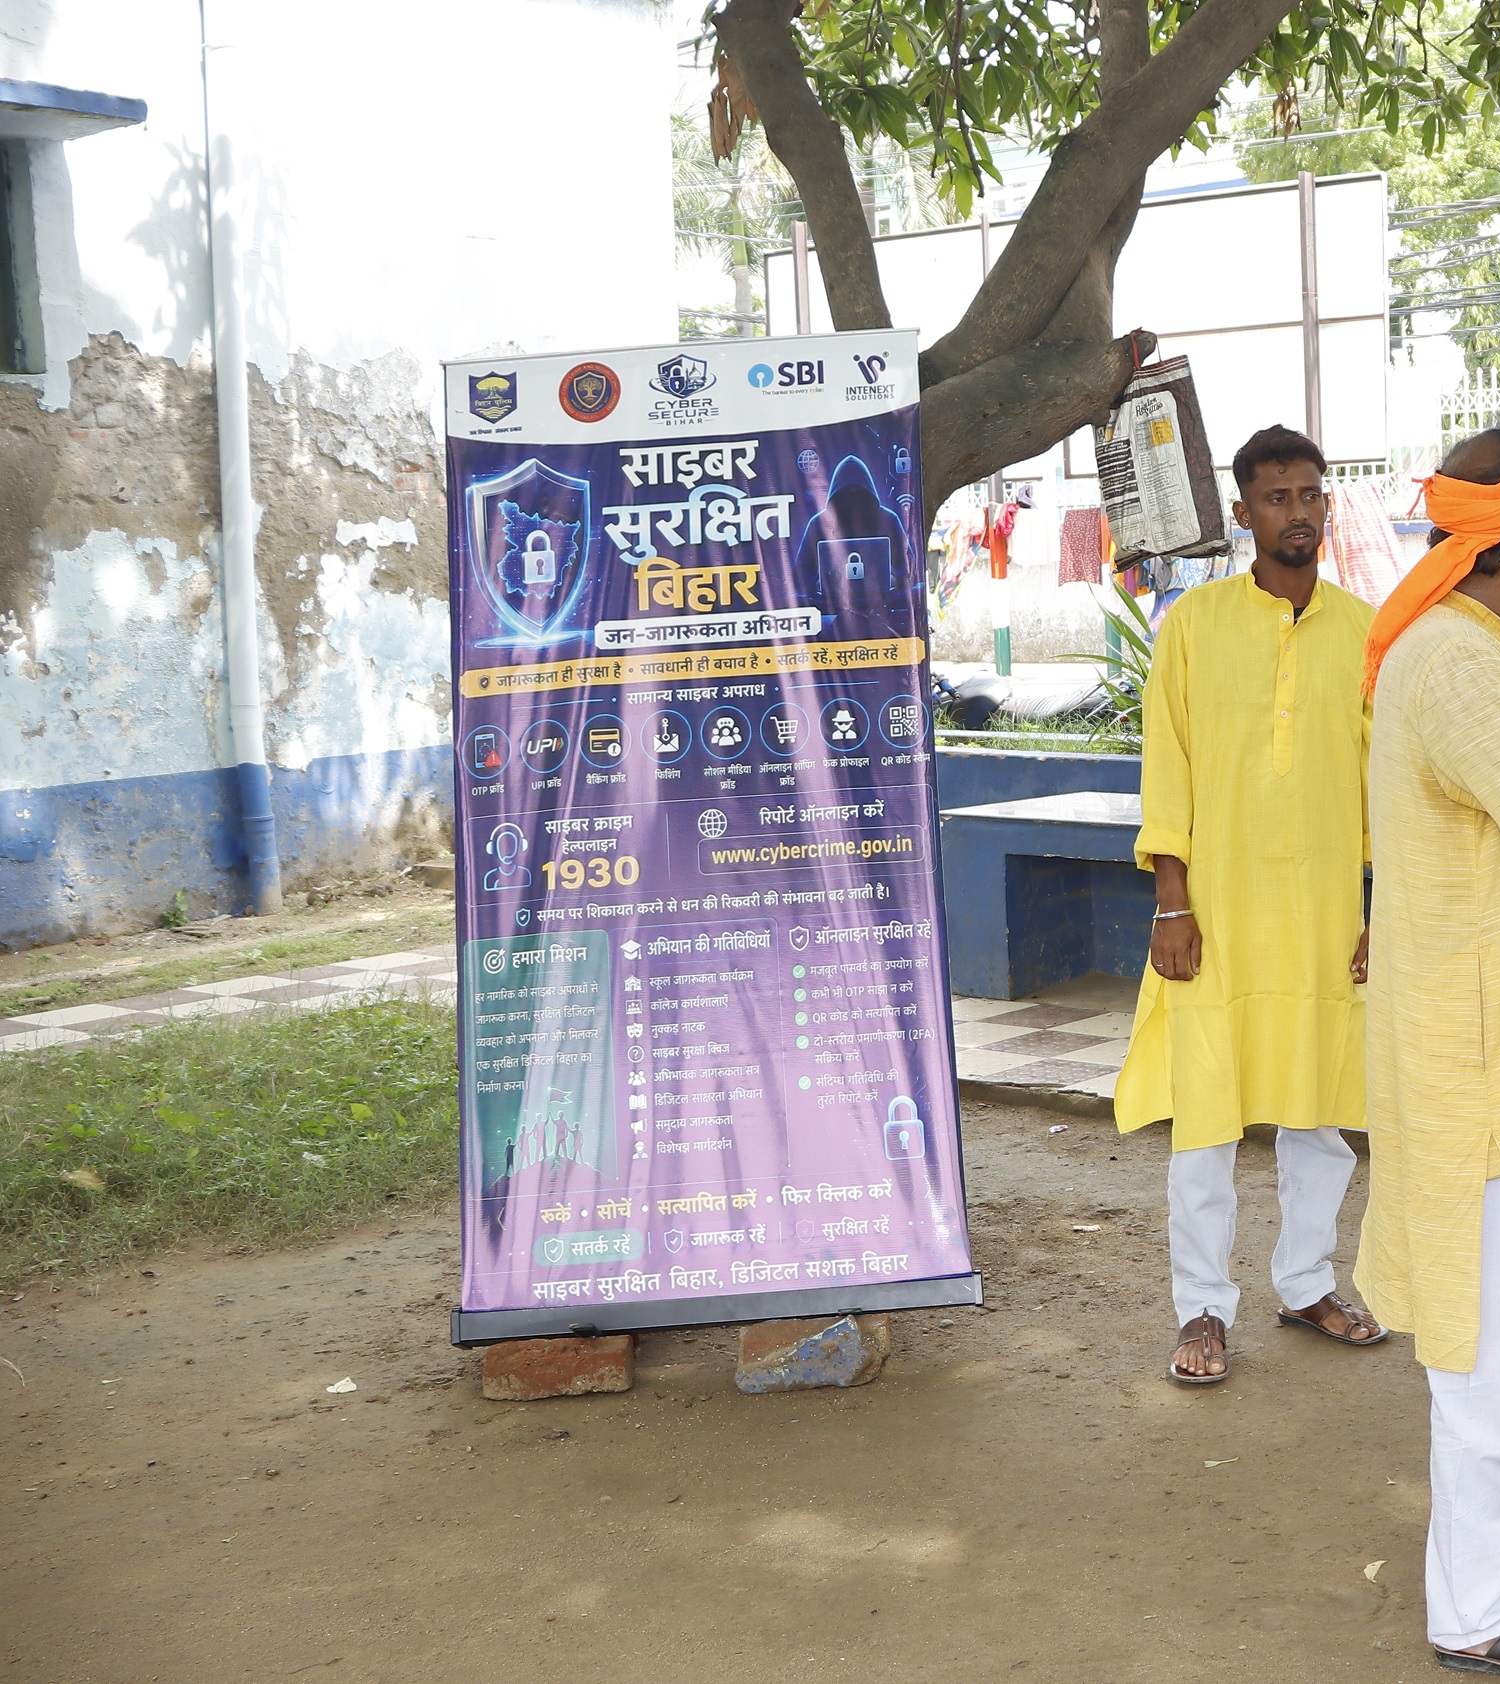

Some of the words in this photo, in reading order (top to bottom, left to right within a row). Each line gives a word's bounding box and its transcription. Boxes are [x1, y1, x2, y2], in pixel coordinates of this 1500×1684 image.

[778, 360, 824, 387] SBI
[846, 384, 895, 395] INTENEXT
[846, 393, 894, 401] SOLUTIONS
[648, 407, 719, 420] SECURE
[654, 398, 713, 410] CYBER
[619, 440, 759, 489] साइबर
[602, 484, 795, 566] सुरक्षित
[634, 557, 761, 612] बिहार
[604, 620, 737, 644] जन-जागरूकता
[742, 615, 811, 635] अभियान
[497, 670, 558, 688] जागरूकता
[562, 666, 573, 682] ही
[577, 666, 609, 682] सुरक्षा
[614, 662, 621, 678] है
[641, 657, 692, 676] सावधानी
[697, 656, 710, 672] ही
[714, 656, 746, 670] बचाव
[750, 653, 758, 667] है
[777, 649, 809, 666] सतर्क
[813, 647, 832, 664] रहें,
[836, 646, 879, 666] सुरक्षित
[883, 644, 899, 660] रहें
[626, 689, 673, 704] सामान्य
[677, 686, 718, 702] साइबर
[722, 684, 765, 698] अपराध
[527, 737, 557, 754] UPI
[703, 767, 726, 777] सोशल
[728, 764, 752, 776] मीडिया
[822, 759, 838, 769] फेक
[840, 756, 869, 768] प्रोफाइल
[881, 756, 894, 767] QR
[895, 755, 911, 765] कोड
[611, 772, 627, 784] फ्रॉड
[655, 768, 681, 780] फिशिंग
[471, 786, 488, 796] OTP
[531, 780, 546, 790] UPI
[547, 778, 562, 788] फ्रॉड
[720, 778, 736, 790] फ्रॉड
[760, 805, 795, 826] रिपोर्ट
[800, 804, 859, 824] ऑनलाइन
[863, 799, 885, 817] करें
[545, 818, 590, 834] साइबर
[594, 815, 633, 831] क्राइम
[562, 838, 617, 854] हेल्पलाइन
[712, 834, 913, 865] www.cybercrime.gov.in
[541, 855, 640, 890] 1930
[537, 909, 564, 921] समय
[568, 908, 583, 920] पर
[587, 904, 634, 918] शिकायत
[637, 898, 663, 915] करने
[667, 897, 677, 912] से
[681, 899, 699, 911] धन
[703, 894, 718, 910] की
[721, 893, 760, 909] रिकवरी
[764, 890, 779, 905] की
[782, 890, 825, 905] संभावना
[847, 883, 874, 899] जाती
[815, 925, 869, 944] ऑनलाइन
[873, 920, 913, 945] सुरक्षित
[917, 919, 931, 939] रहें
[647, 936, 692, 956] अभियान
[695, 933, 710, 952] की
[512, 950, 545, 968] हमारा
[550, 944, 587, 962] मिशन
[840, 959, 868, 973] पासवर्ड
[870, 962, 882, 971] का
[885, 957, 913, 970] उपयोग
[915, 956, 929, 968] करें
[650, 976, 671, 990] स्कूल
[673, 973, 717, 985] जागरूकता
[720, 968, 754, 982] कार्यक्रम
[475, 992, 484, 1003] हर
[487, 988, 515, 1001] नागरिक
[518, 986, 528, 998] को
[530, 986, 556, 998] साइबर
[559, 982, 588, 995] अपराधों
[591, 981, 598, 992] से
[812, 985, 829, 999] कभी
[832, 985, 843, 998] भी
[846, 987, 865, 997] OTP
[867, 985, 888, 995] साझा
[891, 984, 897, 993] न
[900, 981, 913, 993] करें
[650, 997, 678, 1011] कॉलेज
[476, 1014, 506, 1025] जागरूक
[508, 1011, 531, 1022] करना,
[533, 1006, 561, 1022] सुरक्षित
[564, 1005, 595, 1016] डिजिटल
[813, 1013, 827, 1024] QR
[830, 1009, 848, 1022] कोड
[851, 1007, 862, 1020] को
[866, 1005, 901, 1020] सत्यापित
[904, 1004, 917, 1016] करें
[476, 1036, 503, 1048] व्यवहार
[505, 1032, 516, 1044] को
[519, 1032, 549, 1044] अपनाना
[552, 1029, 566, 1041] और
[569, 1028, 598, 1041] मिलकर
[651, 1024, 679, 1038] नुक्कड़
[681, 1021, 706, 1033] नाटक
[814, 1032, 854, 1047] दो-स्तरीय
[857, 1029, 905, 1043] प्रमाणीकरण
[909, 1028, 935, 1041] (2FA)
[652, 1047, 680, 1059] साइबर
[682, 1045, 705, 1059] सुरक्षा
[708, 1042, 730, 1054] क्विज
[815, 1051, 843, 1064] सक्रिय
[845, 1049, 859, 1062] करें
[477, 1061, 490, 1071] एक
[493, 1056, 519, 1072] सुरक्षित
[521, 1054, 554, 1067] डिजिटल
[556, 1052, 578, 1065] बिहार
[580, 1052, 592, 1062] का
[654, 1068, 697, 1082] अभिभावक
[699, 1066, 743, 1079] जागरूकता
[746, 1065, 760, 1075] सत्र
[848, 1070, 884, 1085] गतिविधि
[887, 1068, 899, 1081] की
[477, 1080, 501, 1094] निर्माण
[655, 1092, 689, 1106] डिजिटल
[692, 1091, 725, 1103] साक्षरता
[728, 1087, 763, 1100] अभियान
[817, 1094, 835, 1109] तुरंत
[838, 1090, 861, 1104] रिपोर्ट
[865, 1089, 878, 1102] करें
[656, 1118, 686, 1133] समुदाय
[689, 1115, 733, 1127] जागरूकता
[694, 1136, 732, 1151] मार्गदर्शन
[597, 1197, 632, 1220] सोचें
[657, 1191, 727, 1216] सत्यापित
[731, 1188, 757, 1210] करें
[781, 1185, 813, 1206] फिर
[817, 1182, 863, 1203] क्लिक
[867, 1178, 893, 1200] करें
[690, 1229, 745, 1247] जागरूक
[748, 1223, 766, 1244] रहें
[821, 1217, 868, 1242] सुरक्षित
[873, 1214, 889, 1234] रहें
[571, 1236, 609, 1257] सतर्क
[613, 1233, 631, 1254] रहें
[532, 1279, 592, 1301] साइबर
[597, 1268, 661, 1301] सुरक्षित
[669, 1265, 724, 1290] बिहार,
[730, 1261, 799, 1285] डिजिटल
[805, 1258, 856, 1279] सशक्त
[861, 1250, 909, 1275] बिहार
